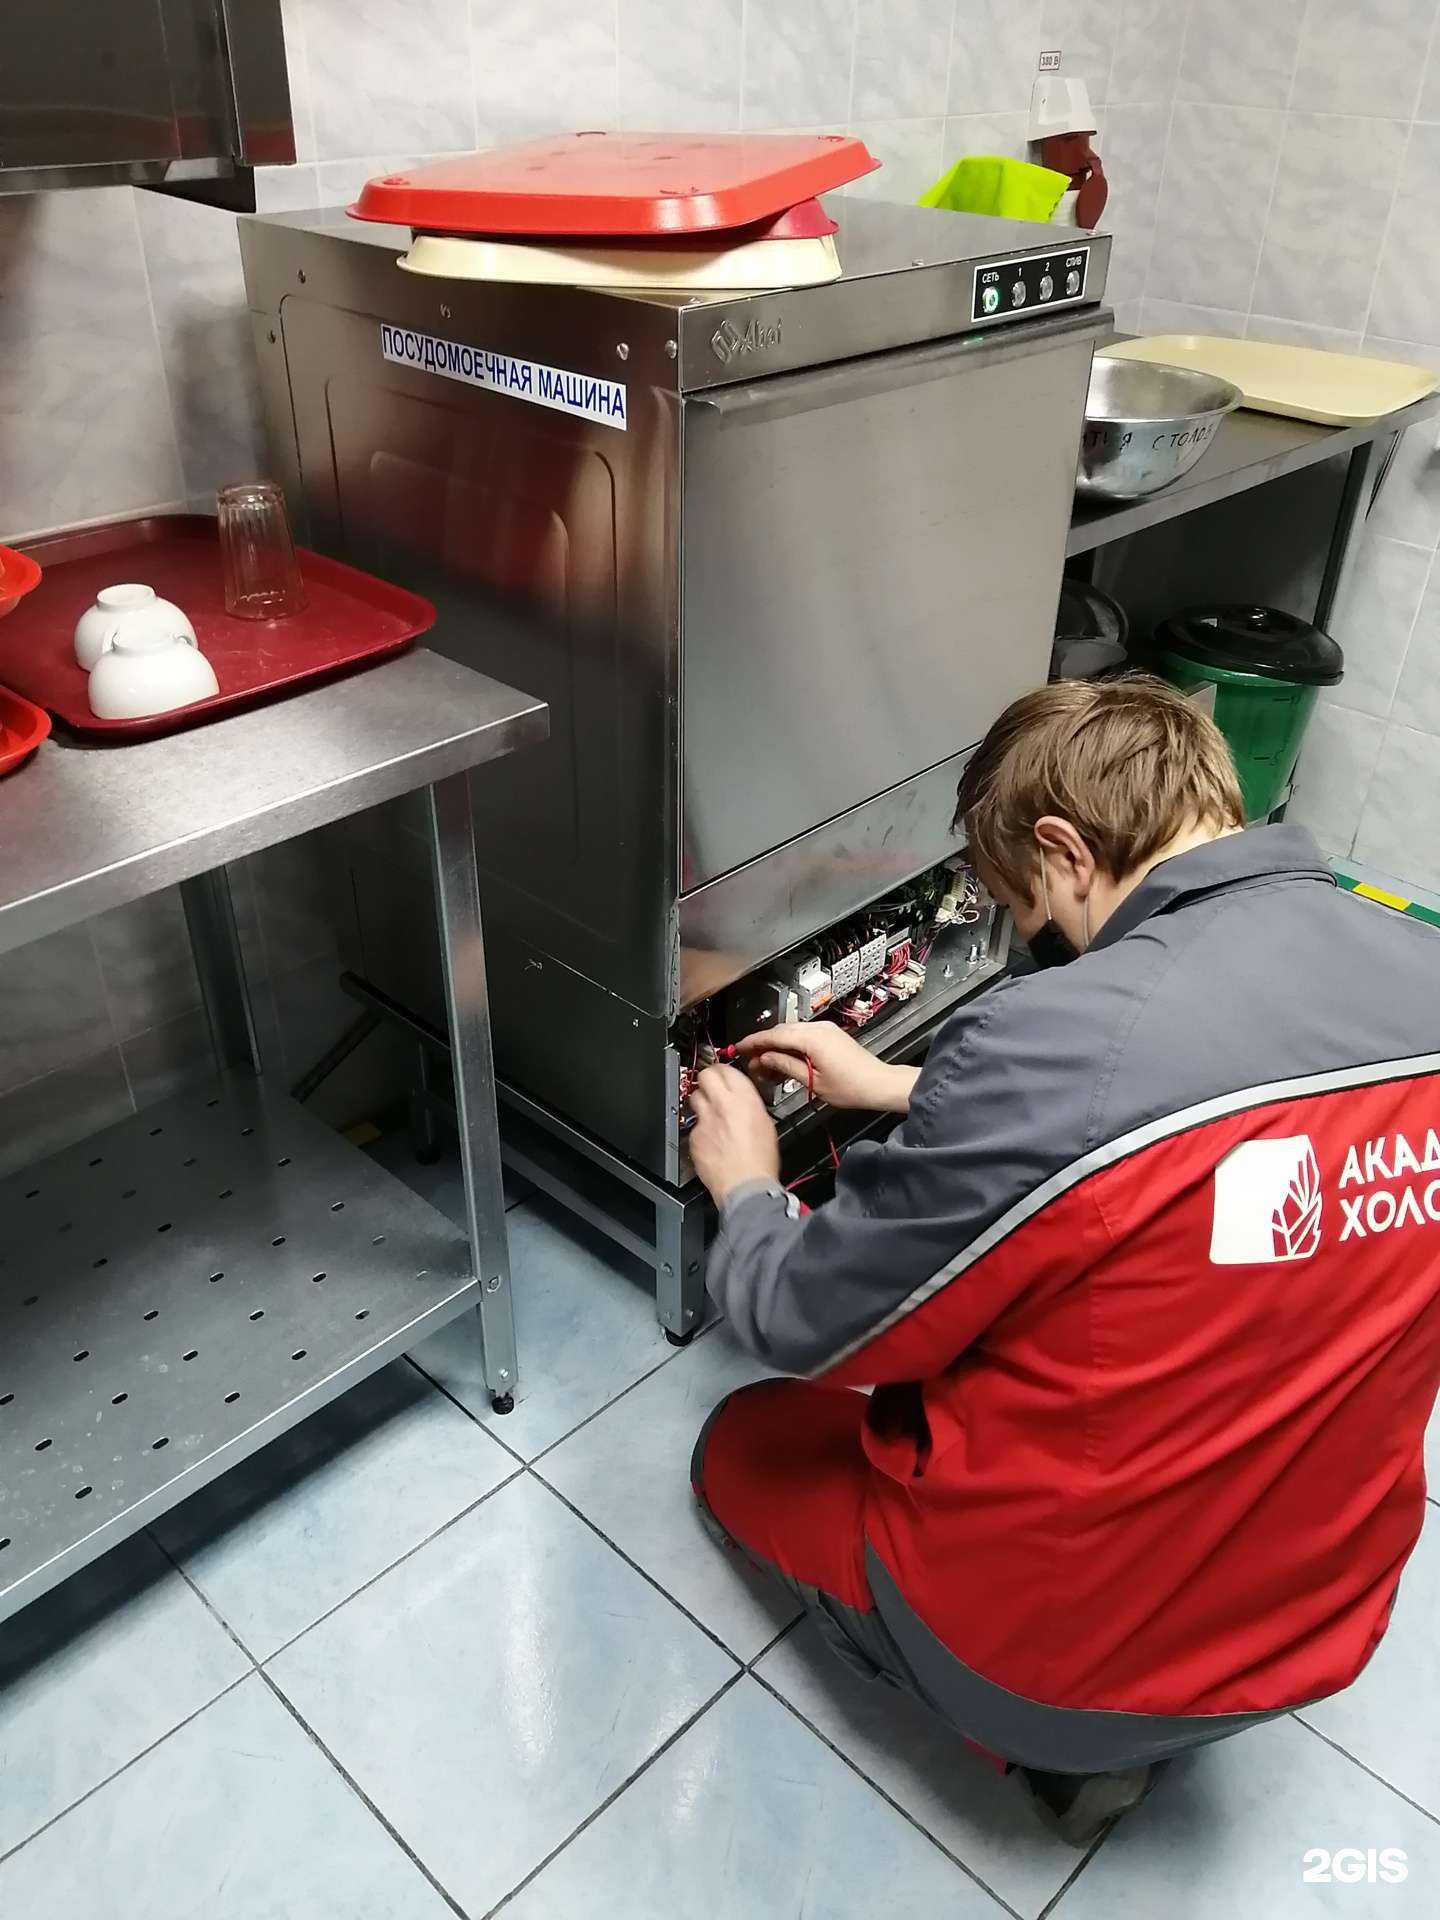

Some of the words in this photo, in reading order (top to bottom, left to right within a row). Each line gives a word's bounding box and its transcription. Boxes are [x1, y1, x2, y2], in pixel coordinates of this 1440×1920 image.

[982, 271, 1000, 284] СЕТЬ
[1018, 267, 1022, 277] 1
[1045, 262, 1050, 272] 2
[1065, 255, 1082, 267] СЛИВ
[382, 326, 533, 394] ПОСУДОМОЕЧНАЯ
[538, 368, 626, 419] МАШИНА
